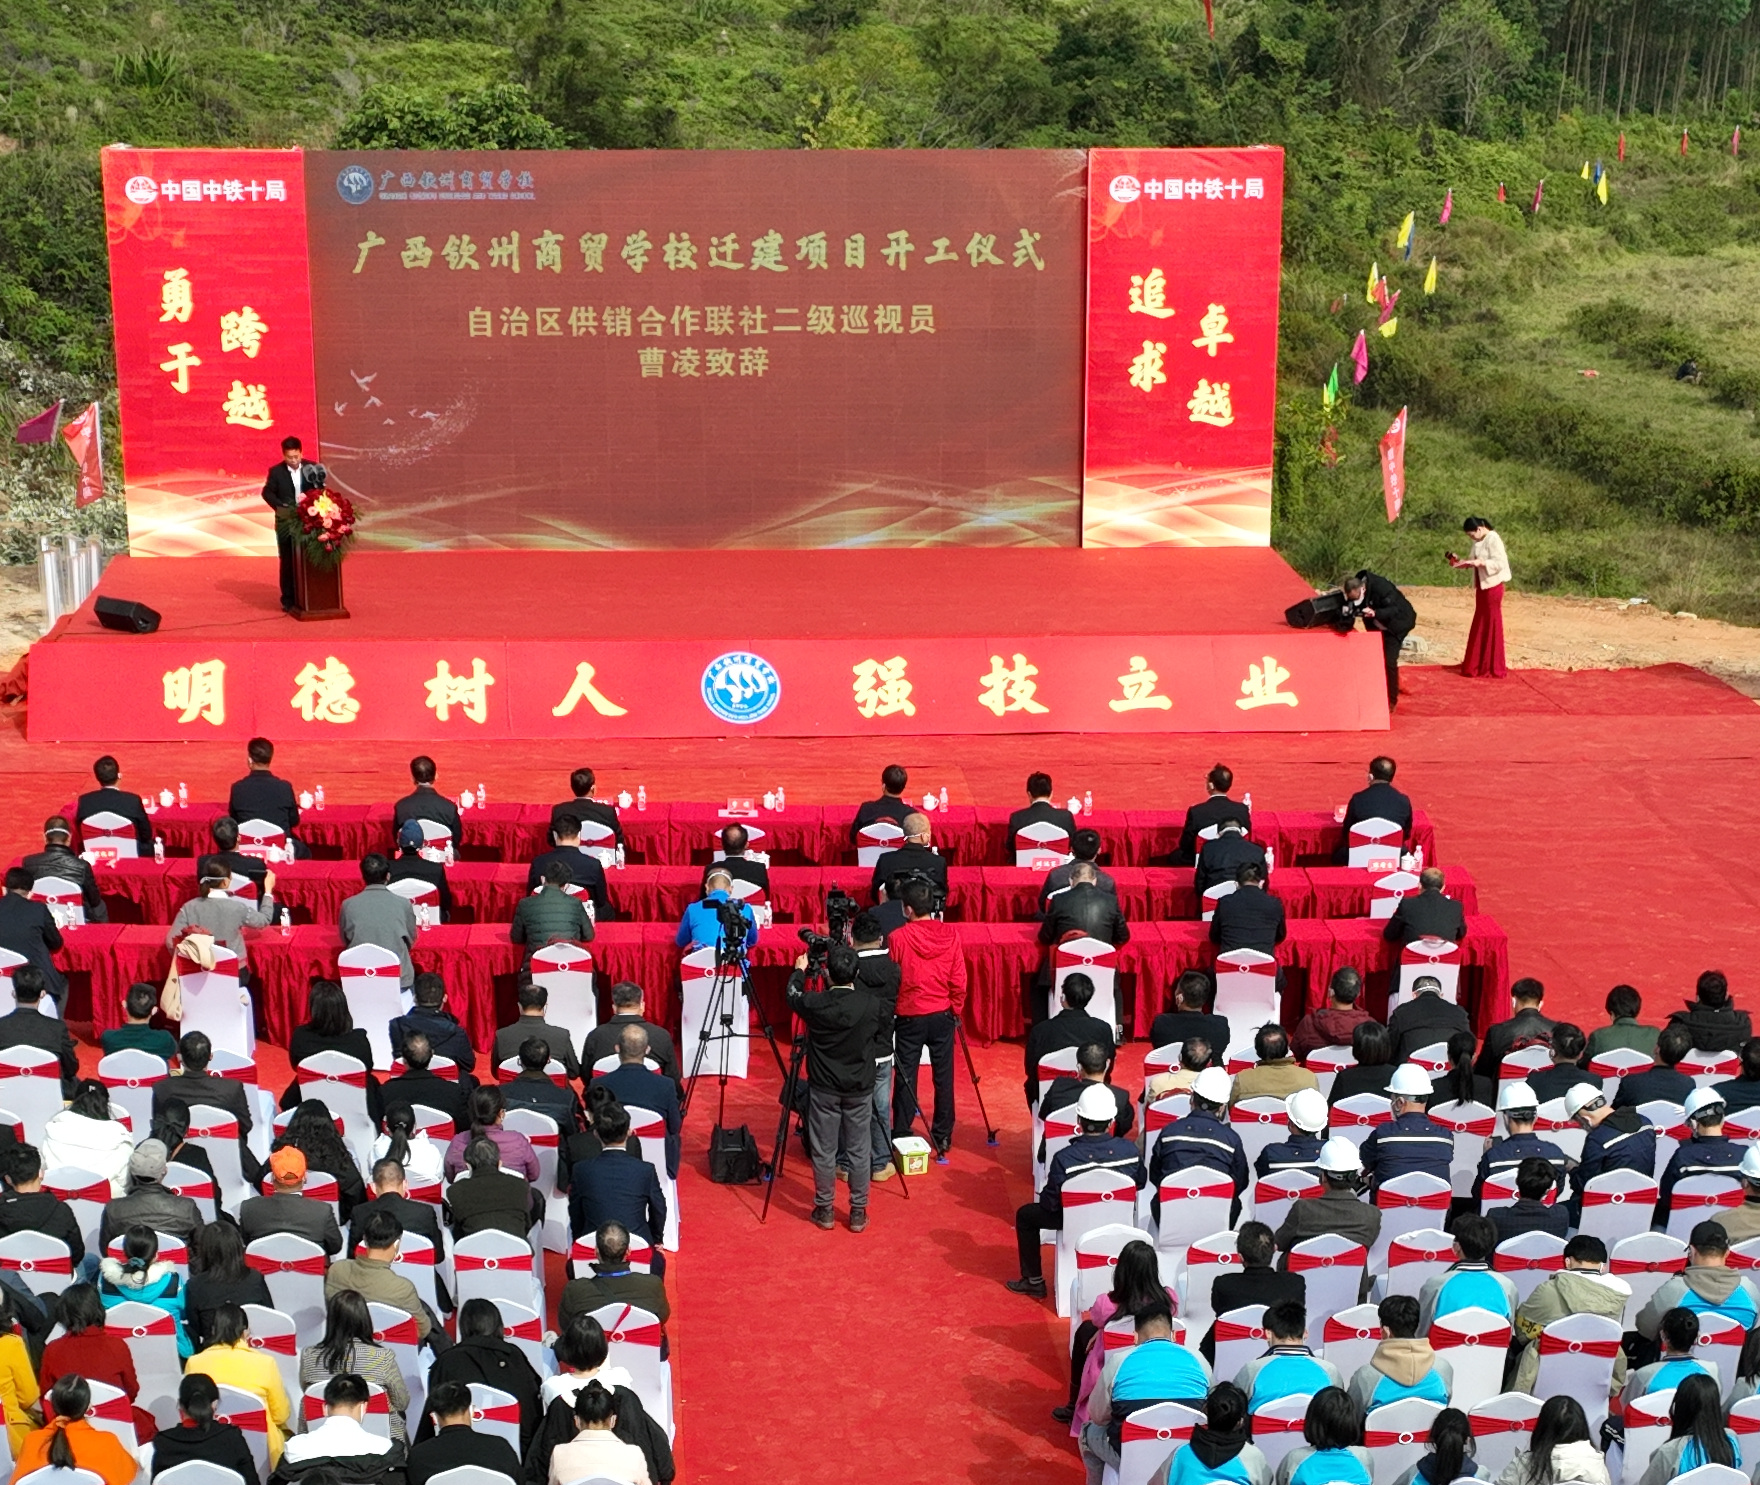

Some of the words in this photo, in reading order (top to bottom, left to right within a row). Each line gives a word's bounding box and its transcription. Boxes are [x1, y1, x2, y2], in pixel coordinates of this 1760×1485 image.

[161, 178, 287, 203] 中国中铁十局
[1144, 177, 1265, 202] 中国中铁十局
[352, 229, 1046, 275] 广西钦州商贸学校迁建项目开工仪式
[159, 267, 202, 394] 勇于
[469, 304, 937, 337] 自治区供销合作联社二级巡视员
[1127, 267, 1176, 393] 追求
[220, 305, 275, 431] 跨越
[639, 347, 770, 378] 曹凌致辞
[1186, 302, 1235, 428] 卓越
[162, 655, 630, 727] 明德树人
[851, 652, 1302, 721] 强技立业
